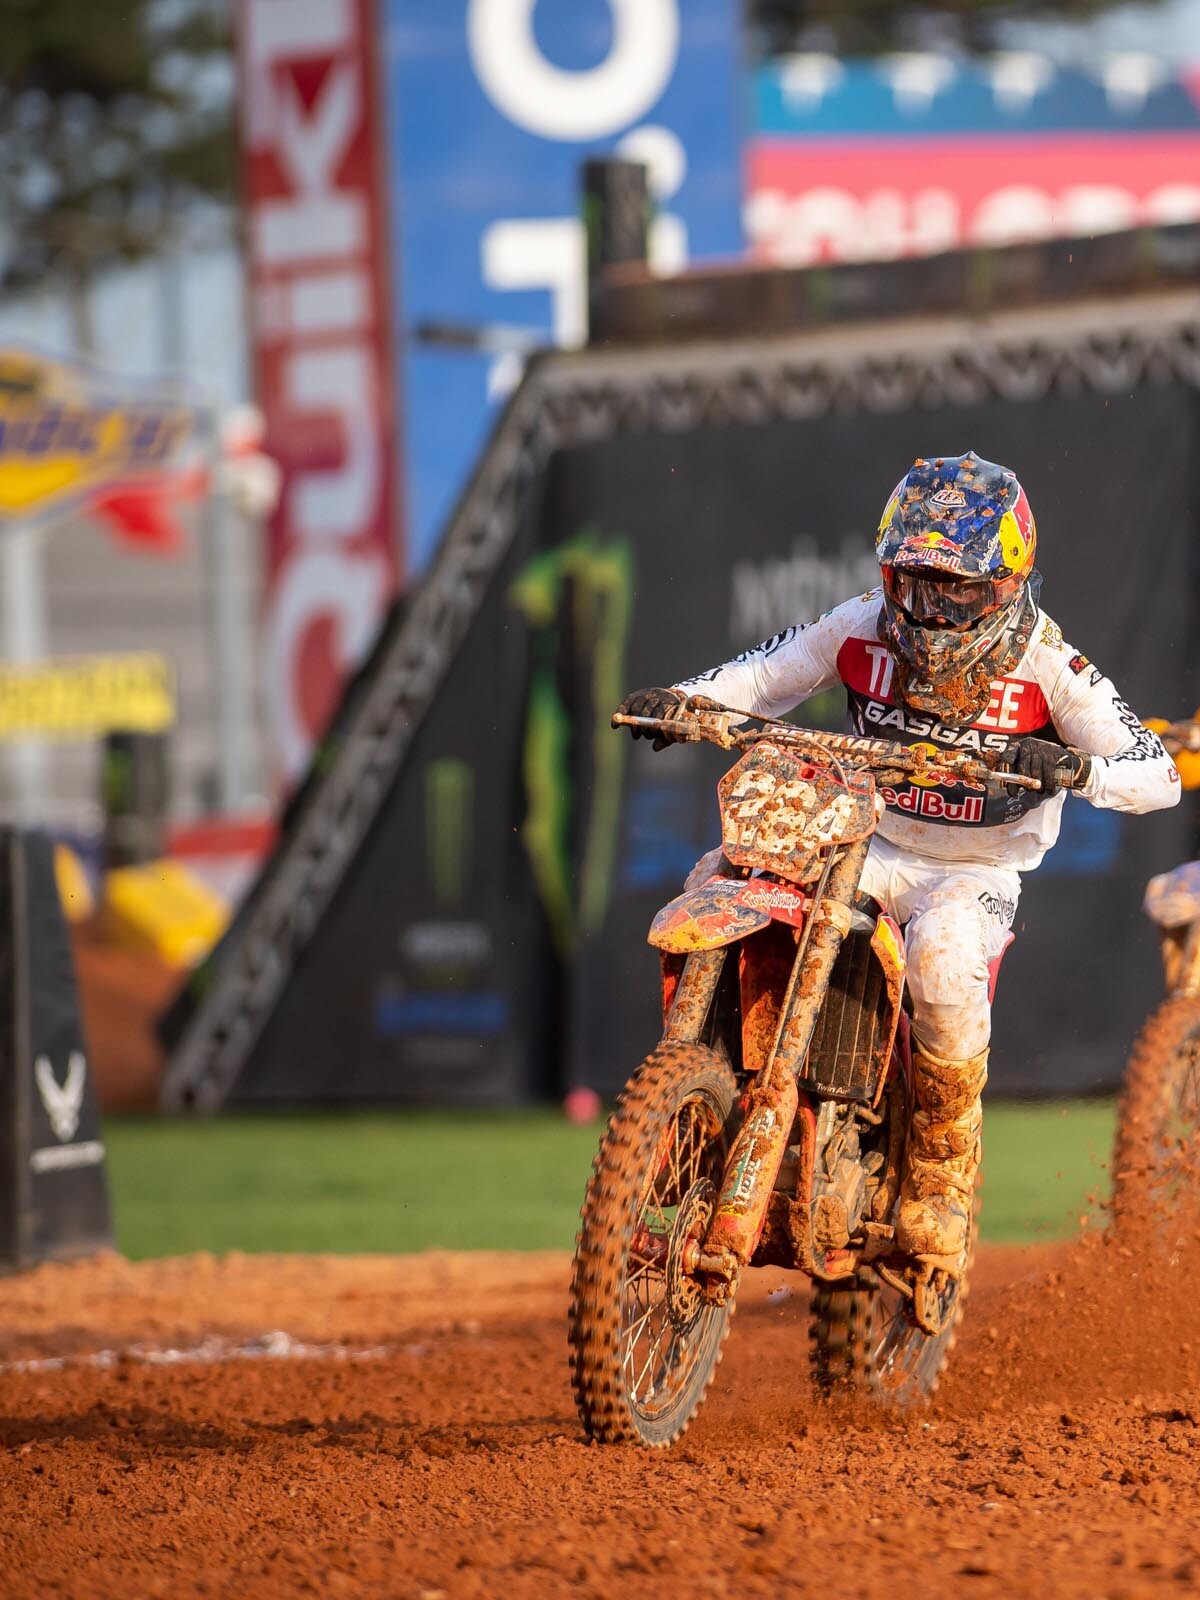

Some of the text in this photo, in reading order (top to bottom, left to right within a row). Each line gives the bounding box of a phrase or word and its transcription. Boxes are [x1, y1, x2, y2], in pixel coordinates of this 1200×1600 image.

[895, 548, 961, 569] Red Bull
[865, 700, 1010, 753] GASGAS
[881, 786, 984, 822] ed Bull
